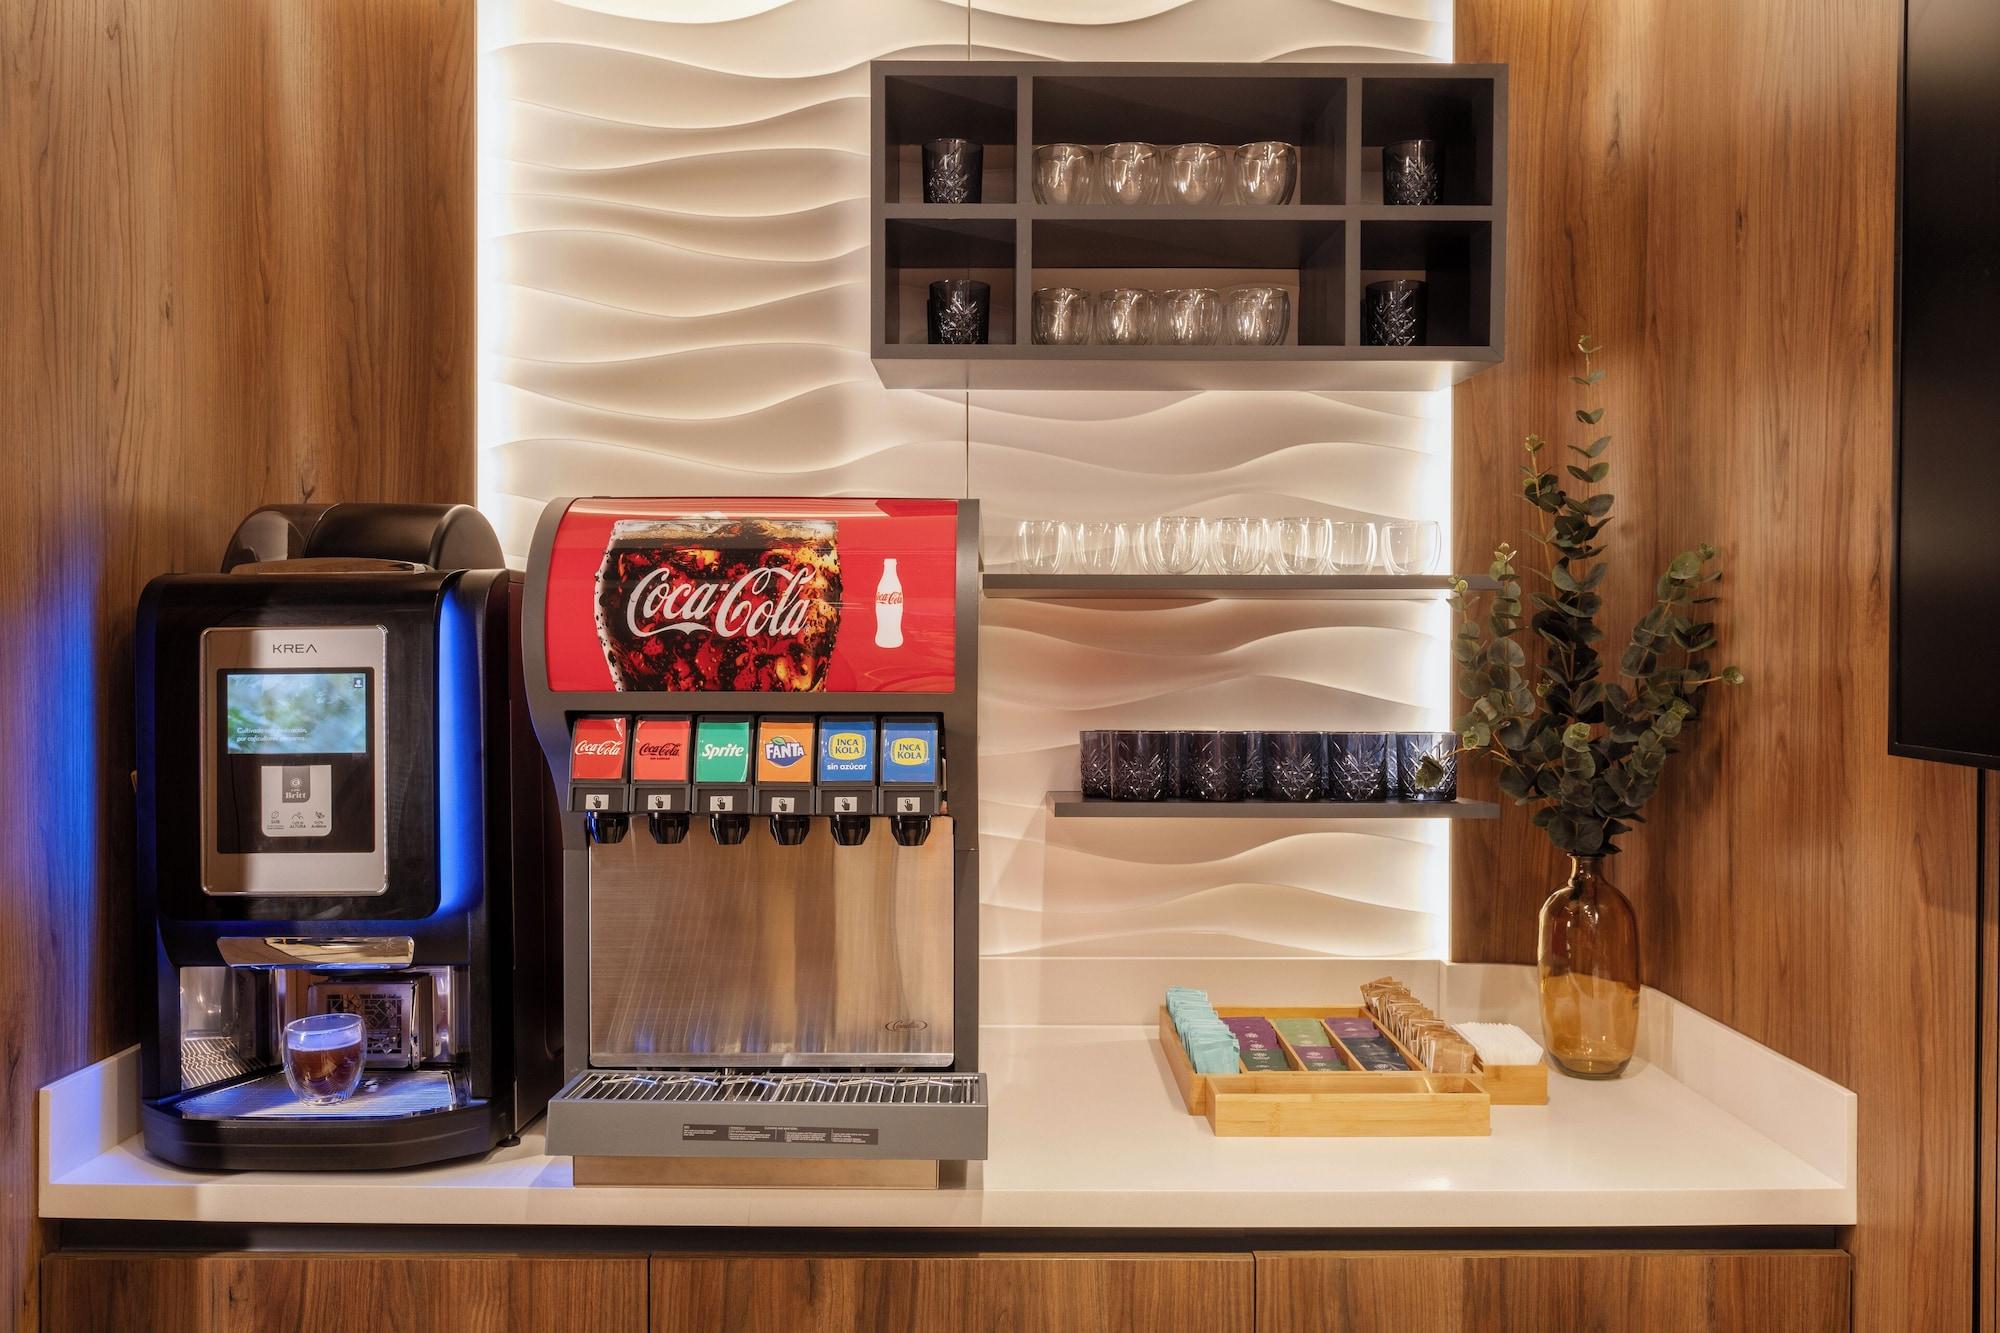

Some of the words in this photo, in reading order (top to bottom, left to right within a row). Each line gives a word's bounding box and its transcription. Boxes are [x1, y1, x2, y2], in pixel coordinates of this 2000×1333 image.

[626, 567, 816, 638] Coca-Cola
[272, 643, 318, 654] KREA
[575, 740, 624, 755] Coca-Cola
[837, 738, 859, 746] INCA
[899, 743, 921, 751] INCA
[639, 743, 681, 756] Coca-Cola
[702, 743, 744, 760] Sprite
[766, 742, 805, 760] FANTA
[835, 746, 860, 754] KOLA
[897, 751, 922, 759] KOLA
